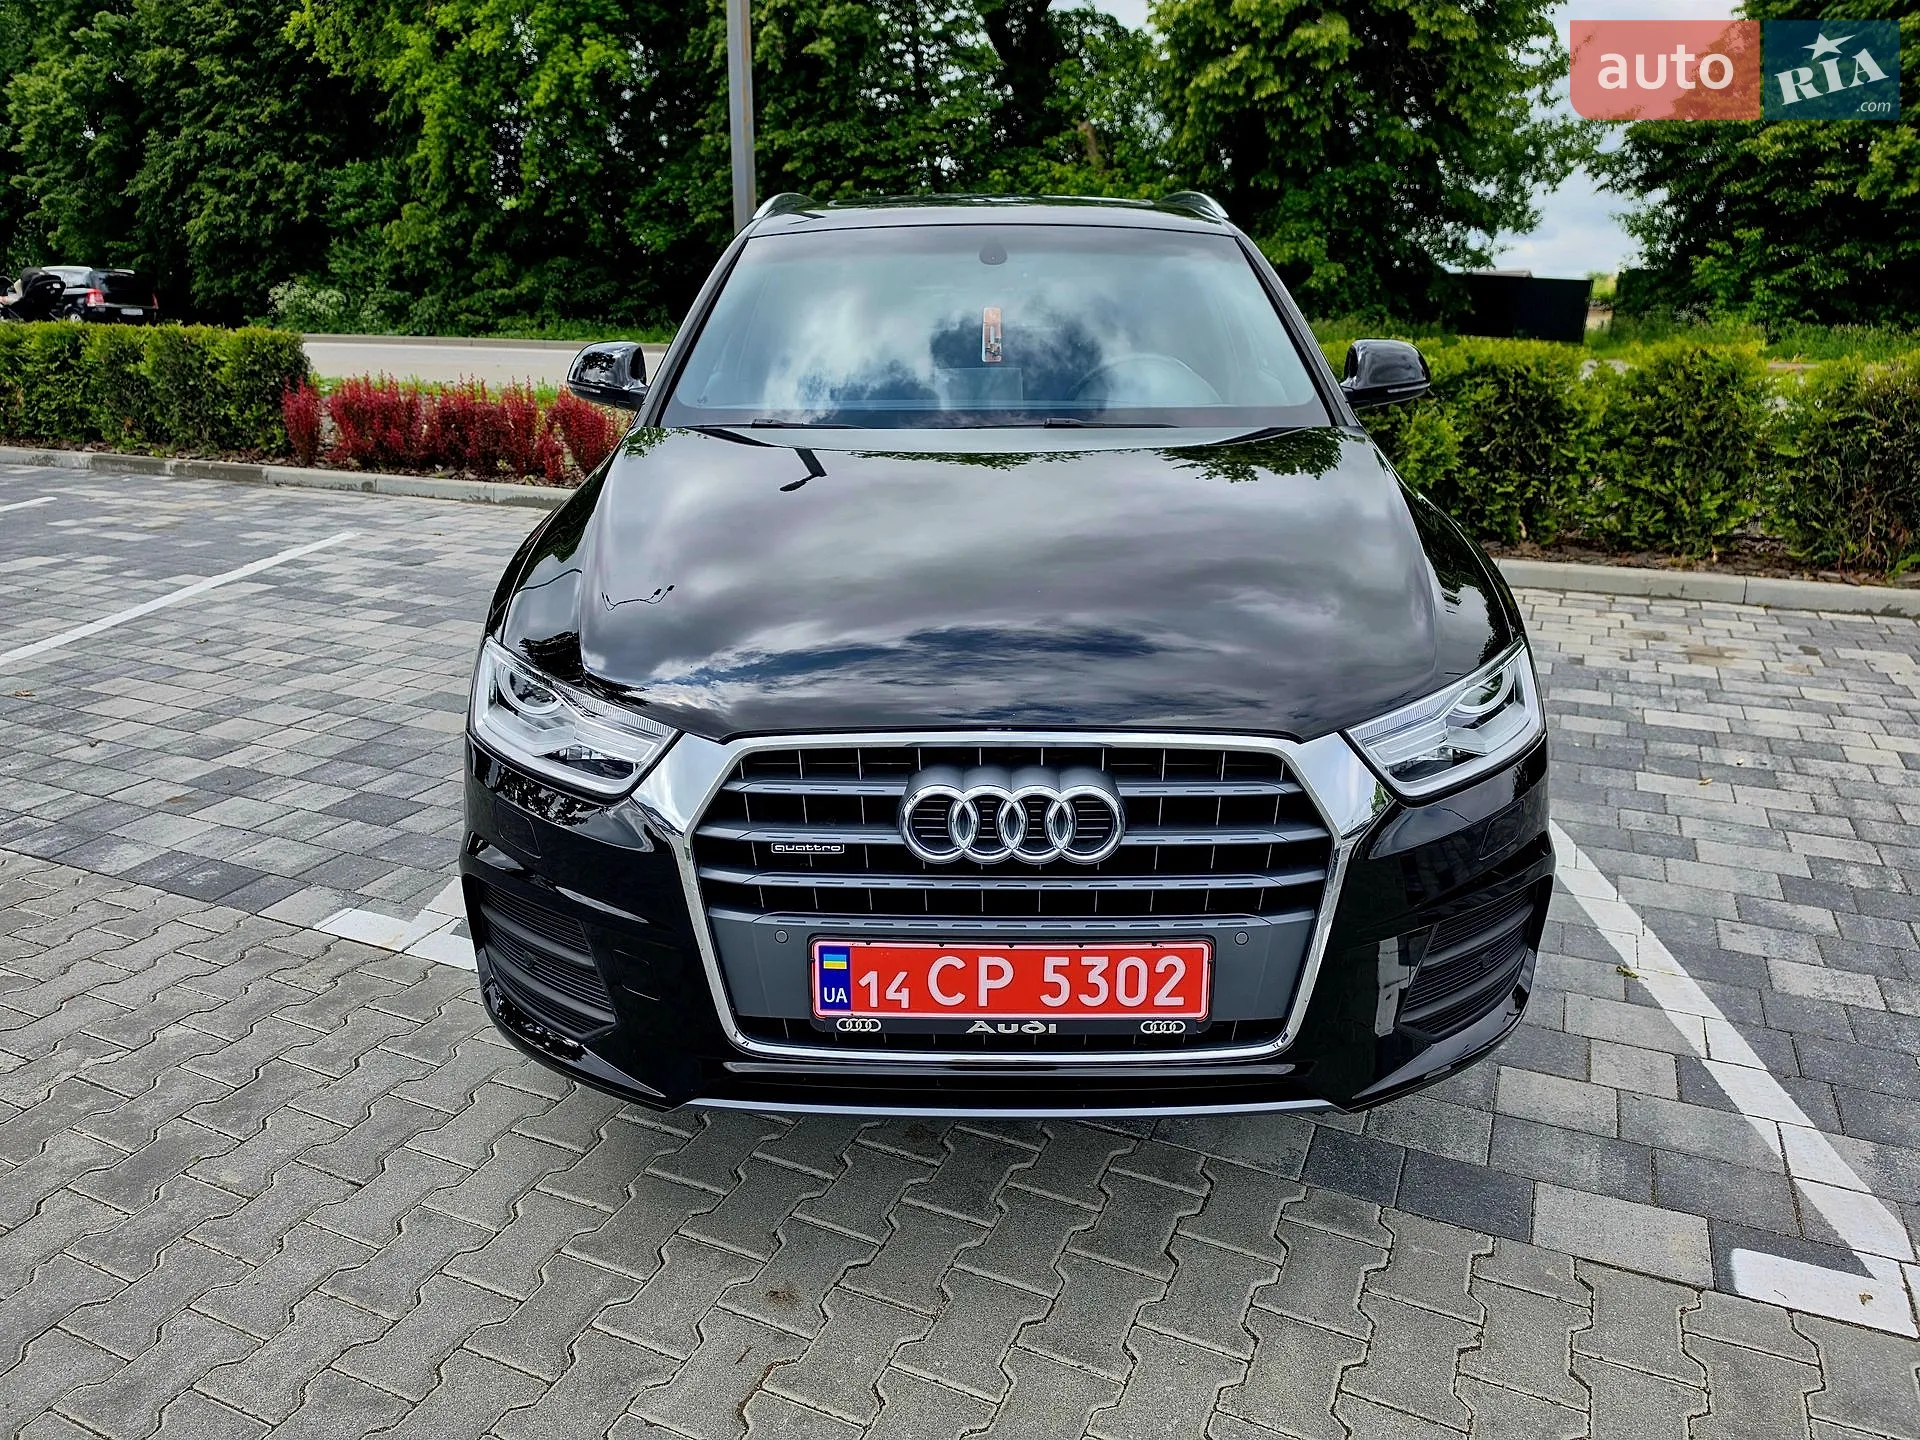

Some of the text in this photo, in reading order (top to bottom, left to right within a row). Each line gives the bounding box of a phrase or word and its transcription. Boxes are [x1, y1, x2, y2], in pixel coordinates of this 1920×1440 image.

[774, 844, 841, 853] quattro
[857, 955, 1187, 1009] 14 CP 5302
[823, 987, 848, 1004] UA
[965, 1020, 1058, 1035] Audi
